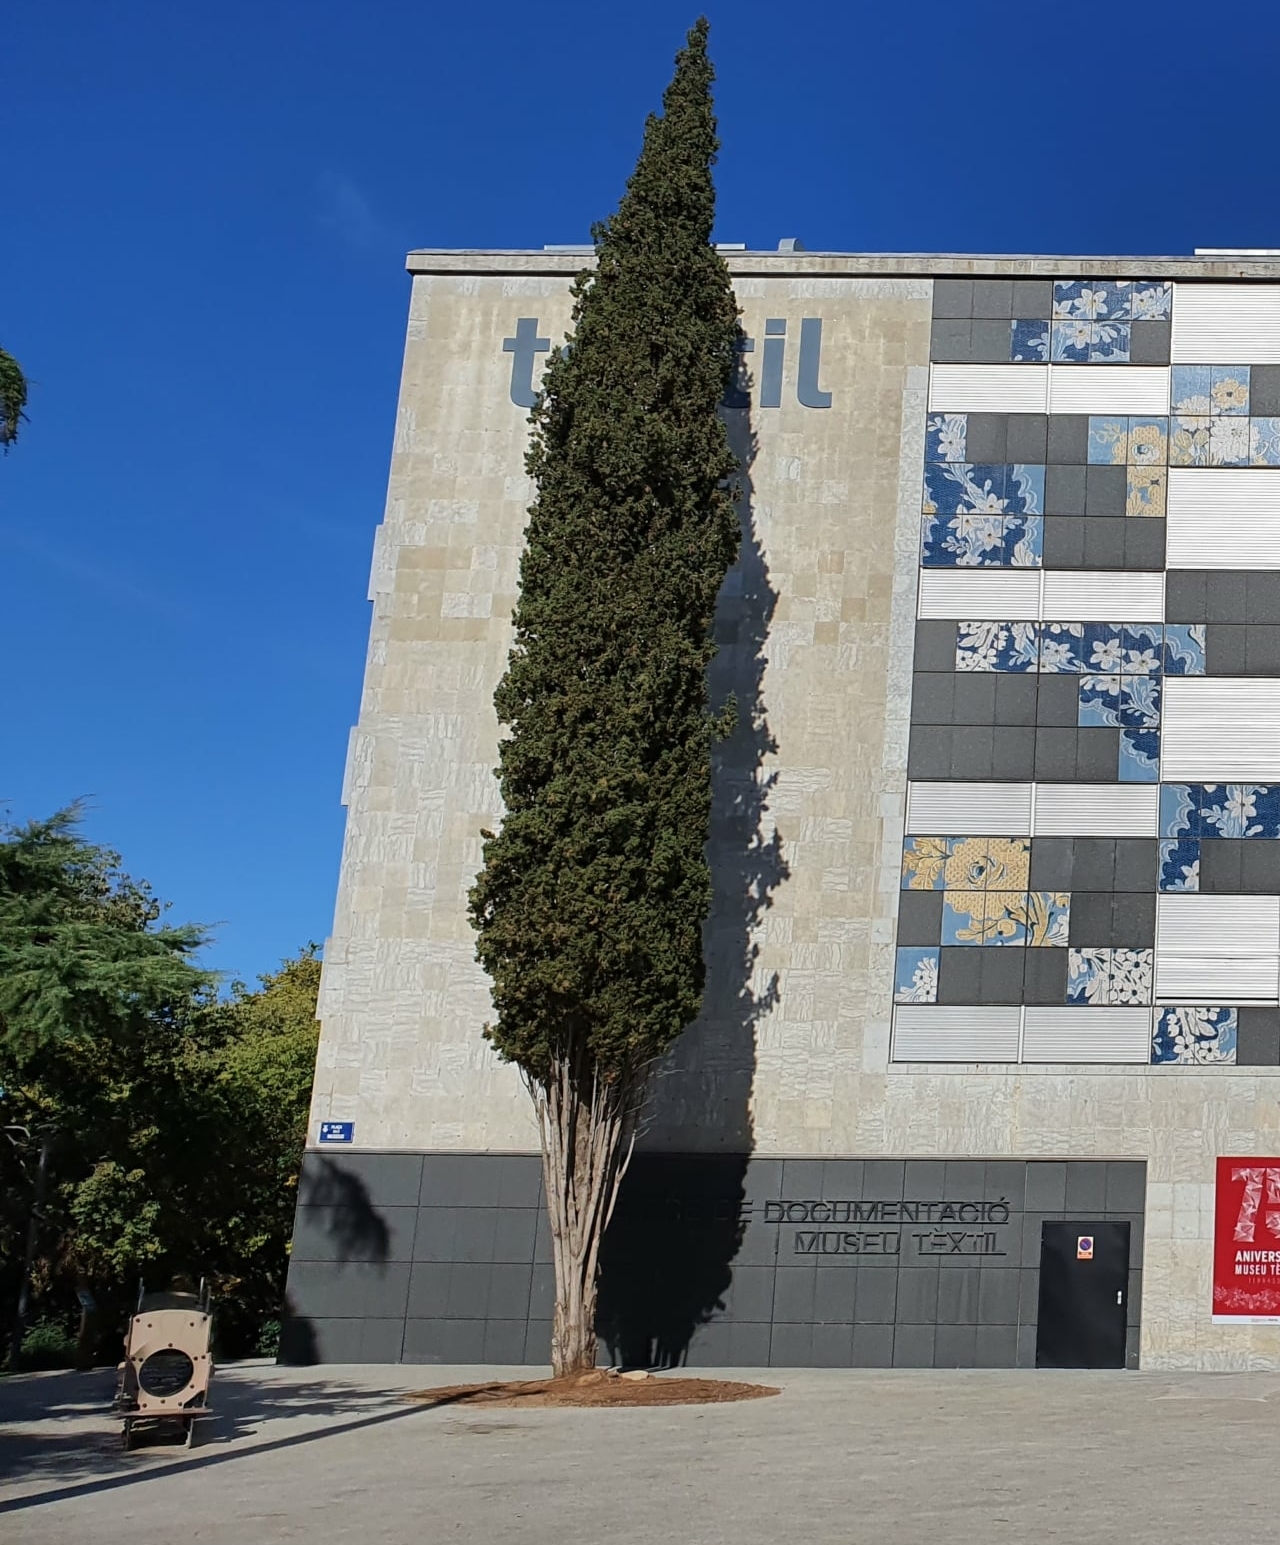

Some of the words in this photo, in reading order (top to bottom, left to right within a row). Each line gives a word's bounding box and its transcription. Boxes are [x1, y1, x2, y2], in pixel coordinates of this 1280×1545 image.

[763, 1196, 1010, 1224] DOCUMENTACIÓ
[793, 1231, 900, 1255] MUSEU
[1234, 1264, 1268, 1276] MUSEU
